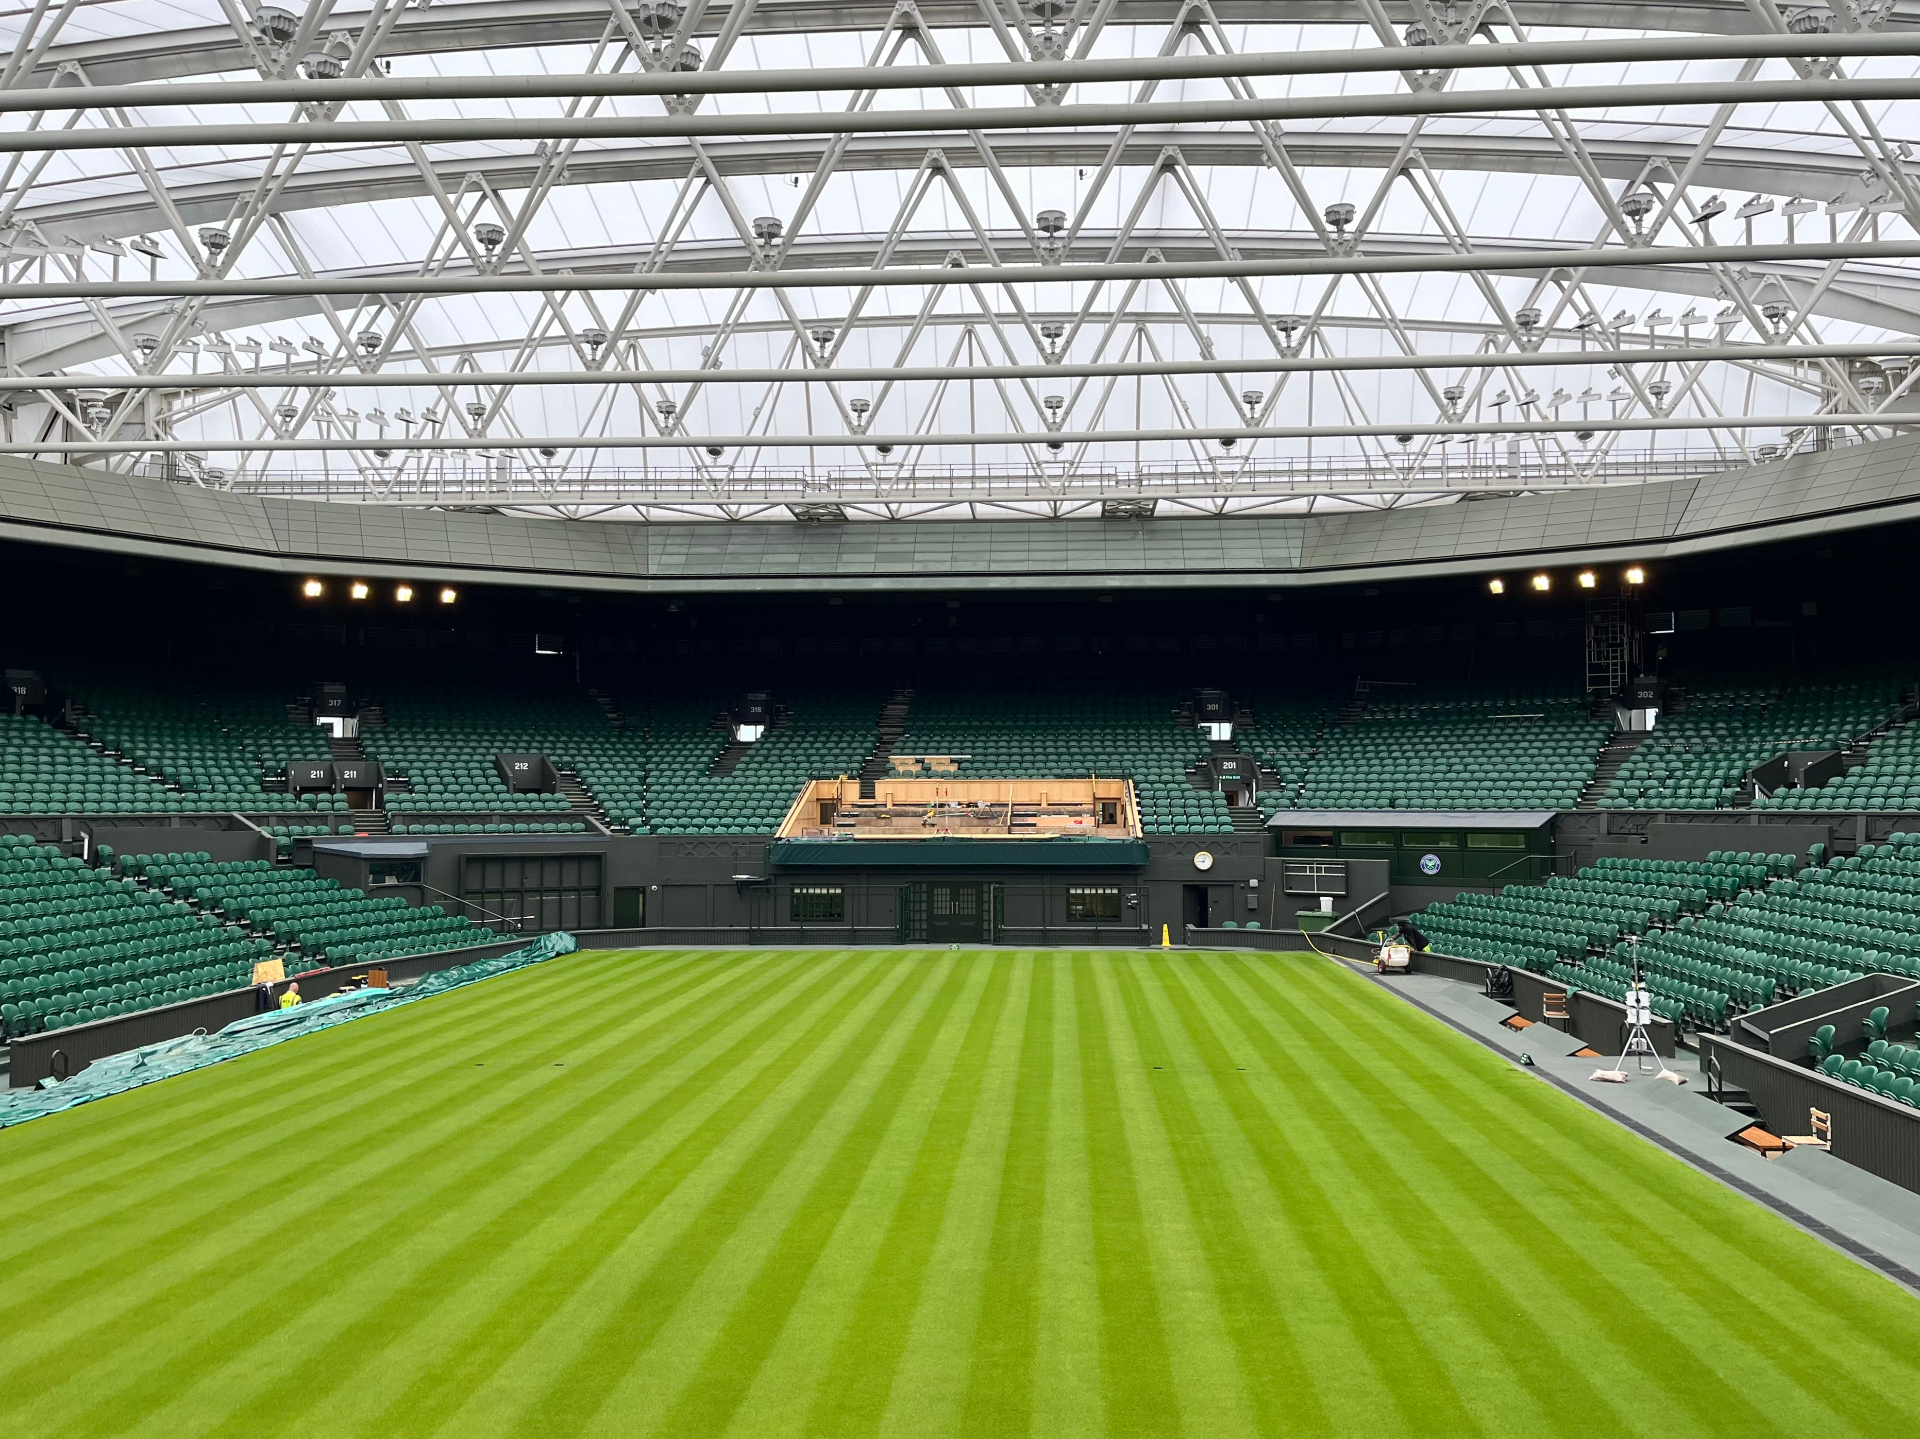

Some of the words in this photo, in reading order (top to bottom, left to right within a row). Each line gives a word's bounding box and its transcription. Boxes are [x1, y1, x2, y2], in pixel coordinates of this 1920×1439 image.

[1637, 691, 1654, 699] 302
[328, 699, 342, 707] 317
[1206, 703, 1219, 711] 301
[514, 762, 529, 770] 212
[1222, 761, 1236, 770] 201
[310, 770, 324, 779] 211
[343, 770, 357, 779] 211
